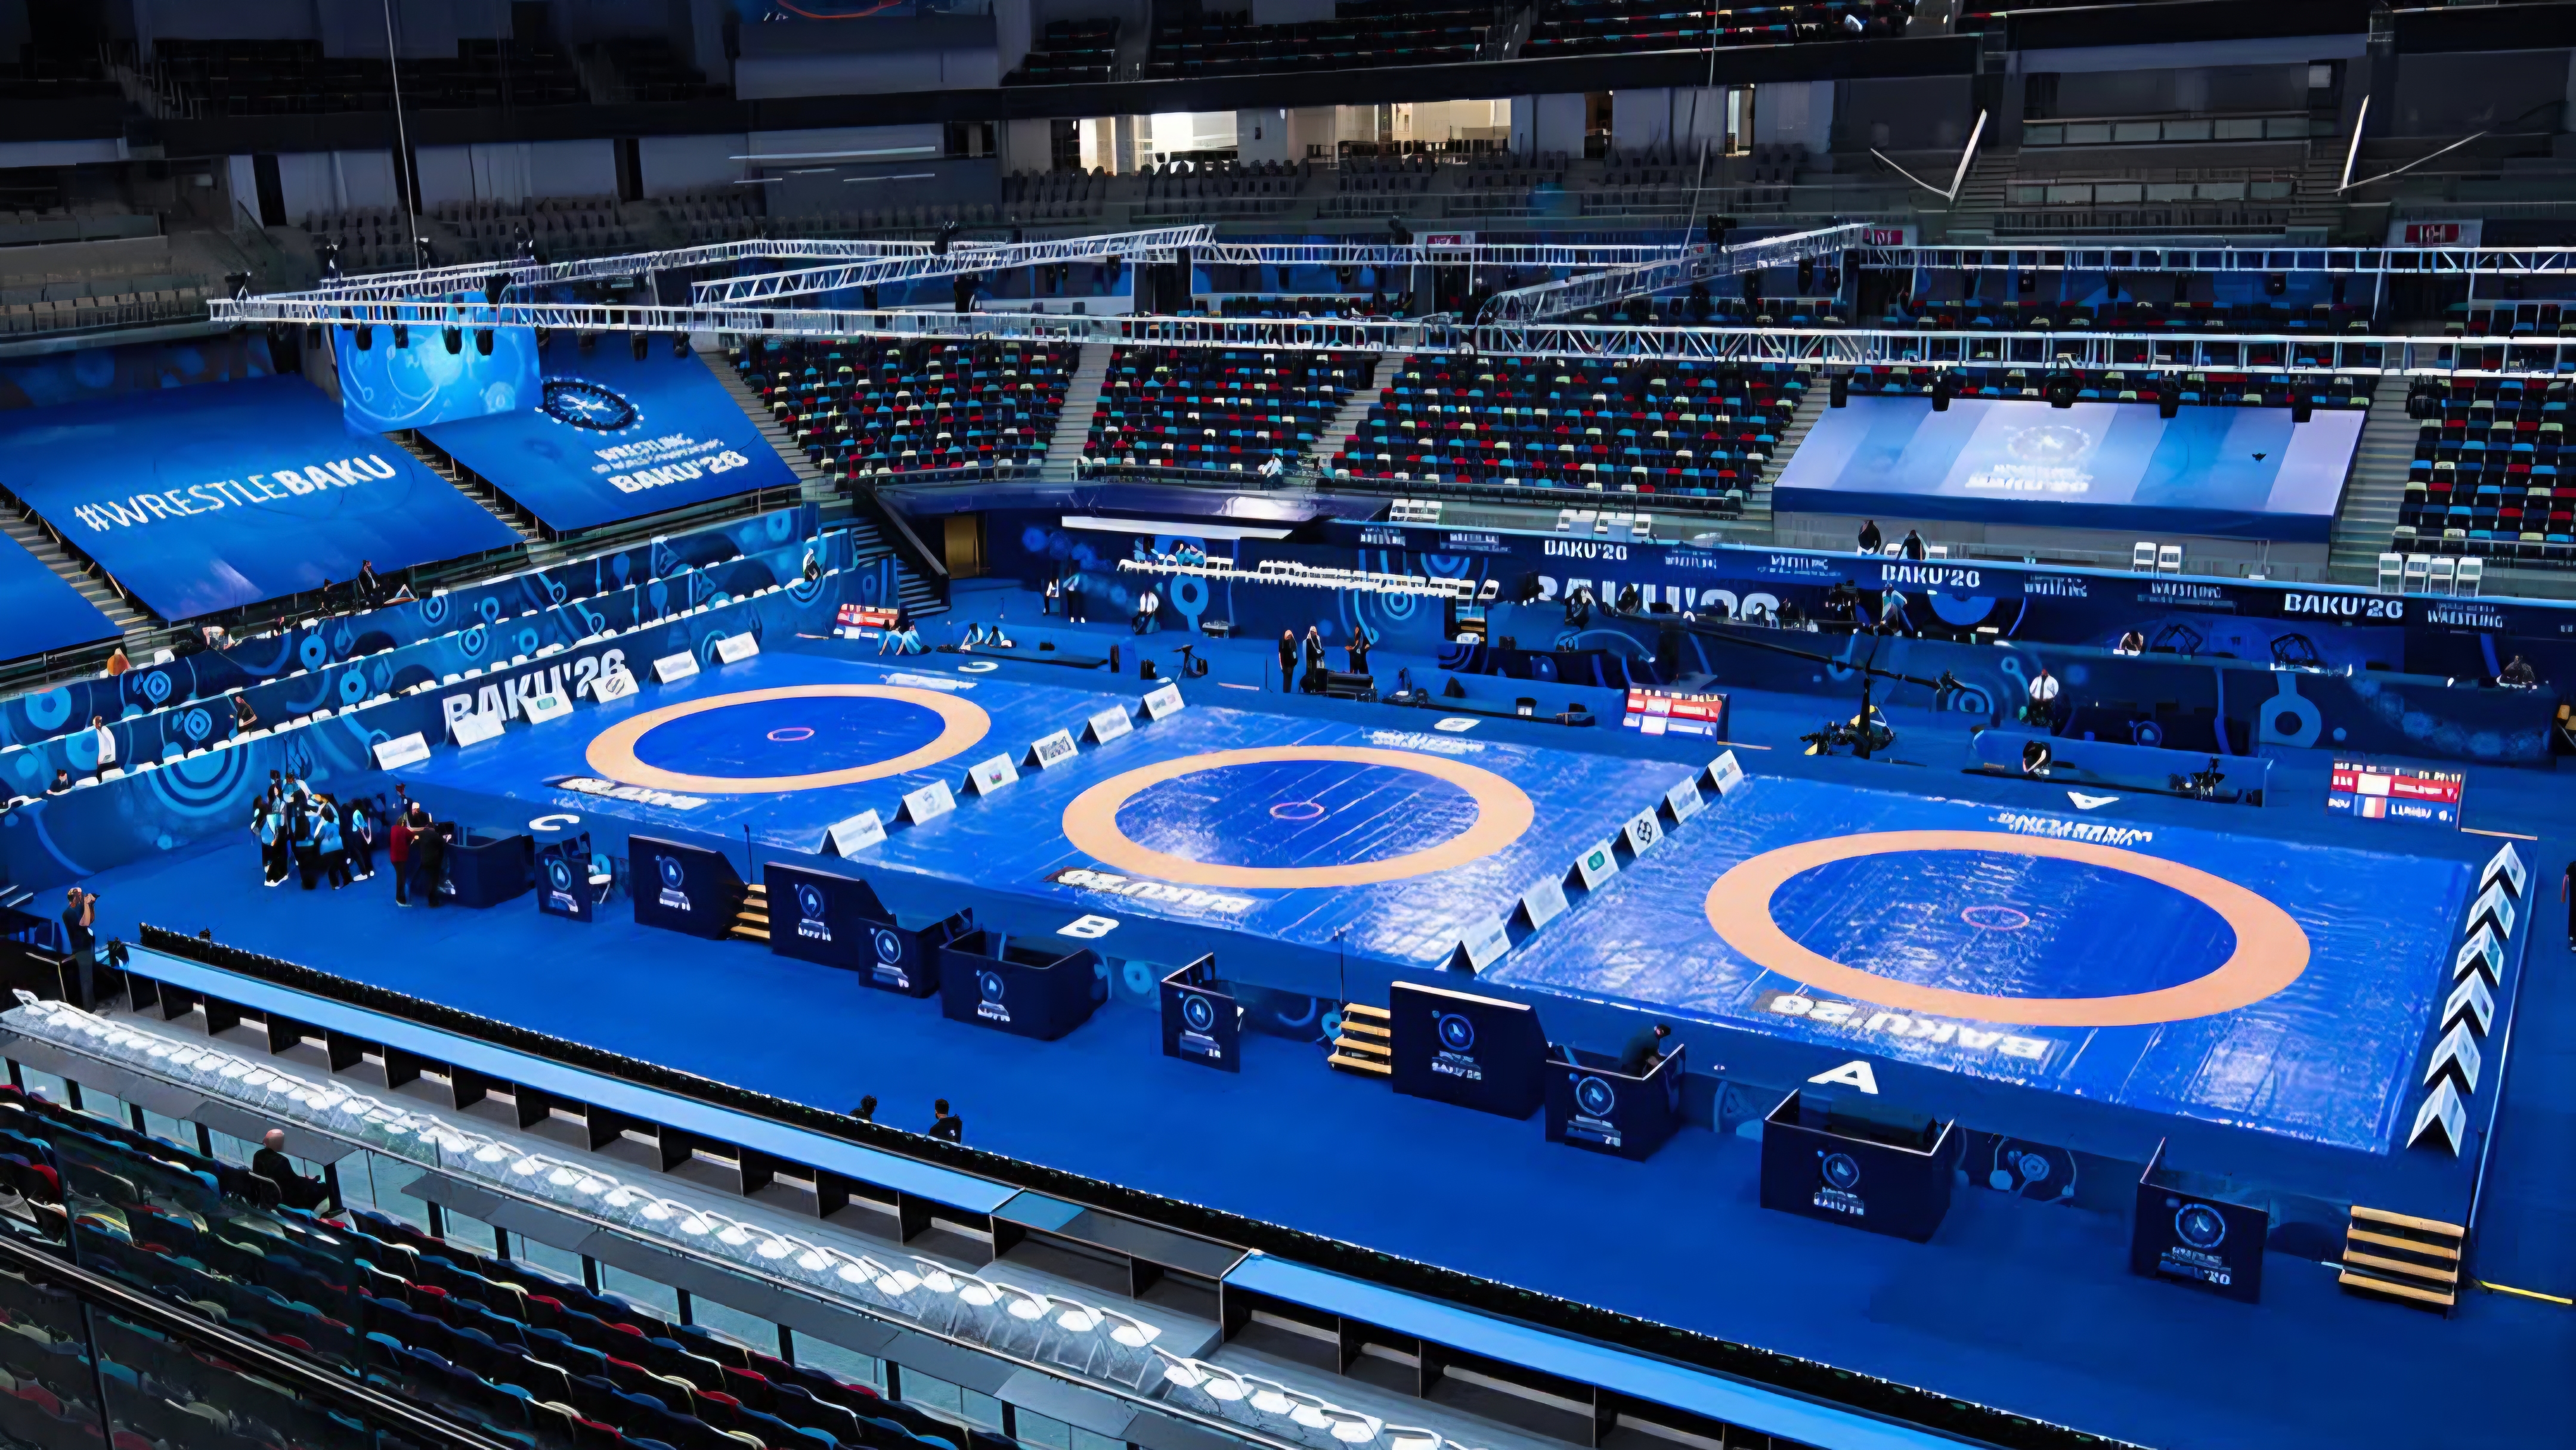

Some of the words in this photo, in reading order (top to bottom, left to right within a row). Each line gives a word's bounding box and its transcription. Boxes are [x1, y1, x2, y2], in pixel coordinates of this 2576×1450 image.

[74, 454, 396, 531] #WRESTLEBAKU
[1056, 915, 1120, 938] B
[1807, 1060, 1879, 1095] A
